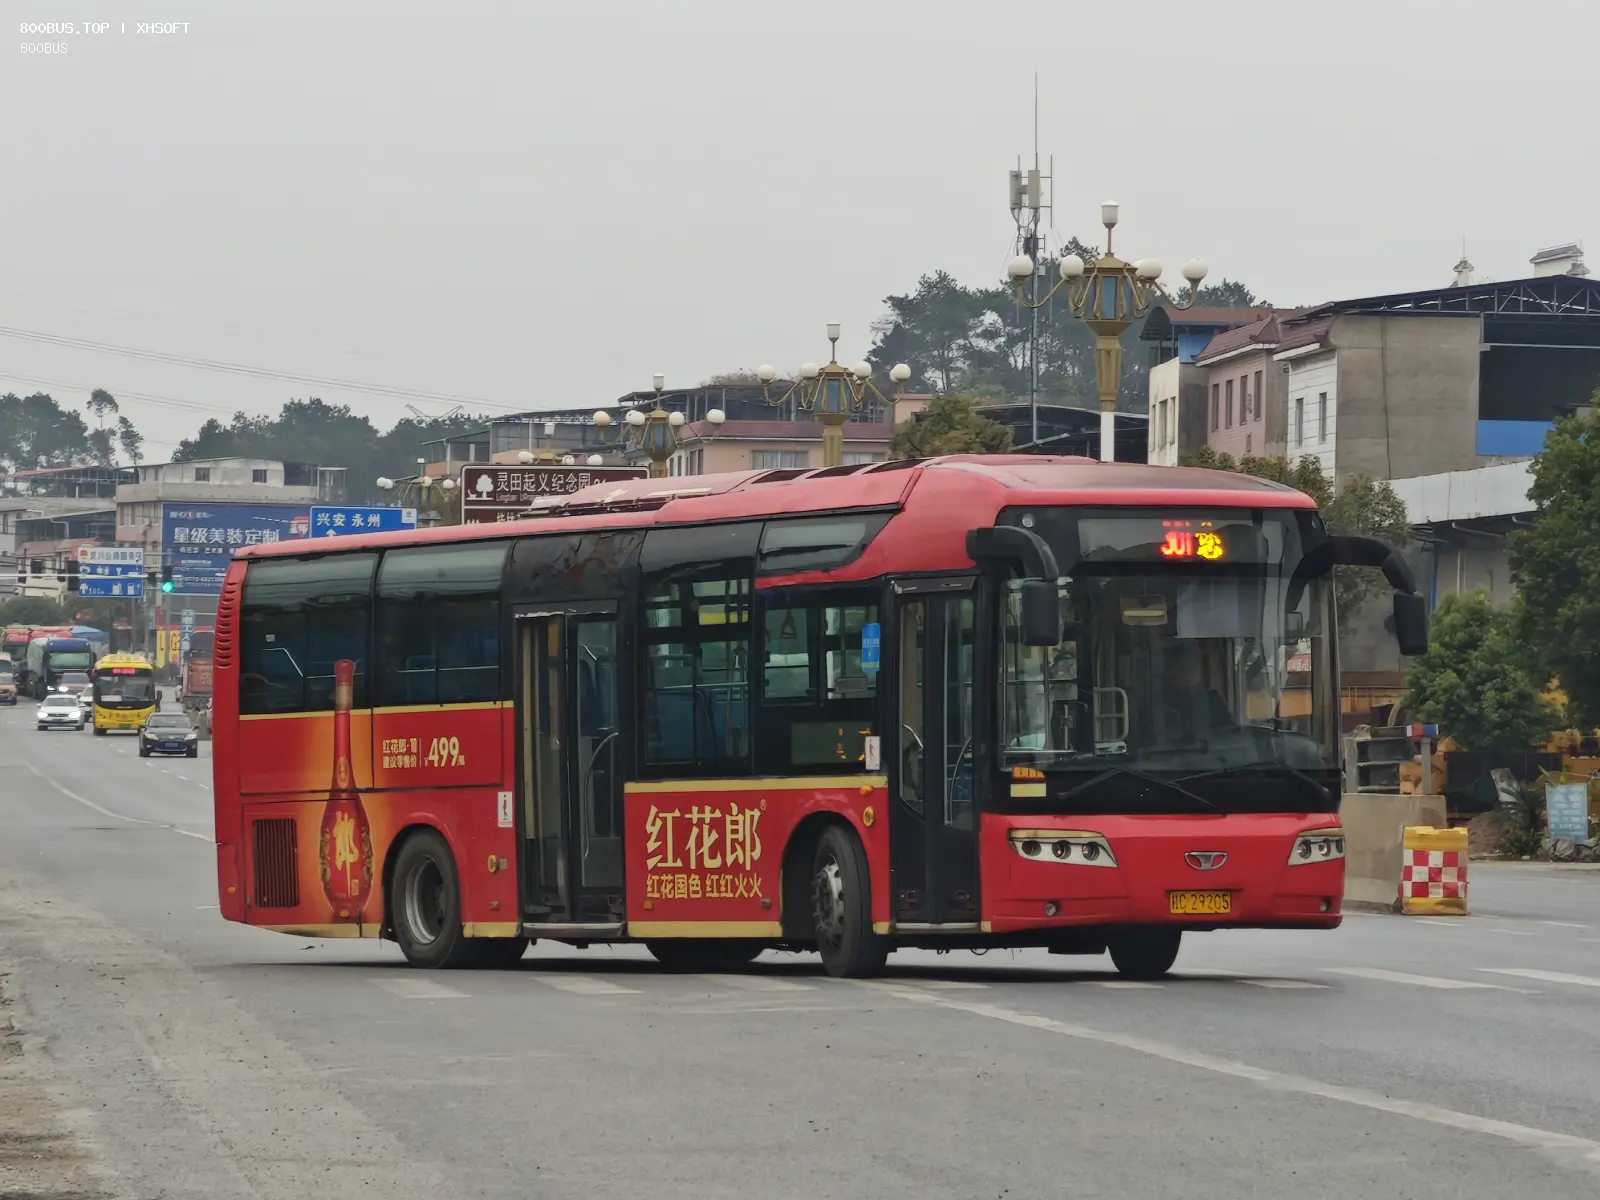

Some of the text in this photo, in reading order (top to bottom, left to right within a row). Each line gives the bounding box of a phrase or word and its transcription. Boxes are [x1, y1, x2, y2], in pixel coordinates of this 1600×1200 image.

[496, 472, 591, 492] 灵田起义纪念园
[316, 512, 381, 528] 兴安 永州
[173, 527, 280, 545] 星级美装定制
[645, 802, 762, 871] 红花郎
[646, 873, 763, 899] 红花国色 红红火火
